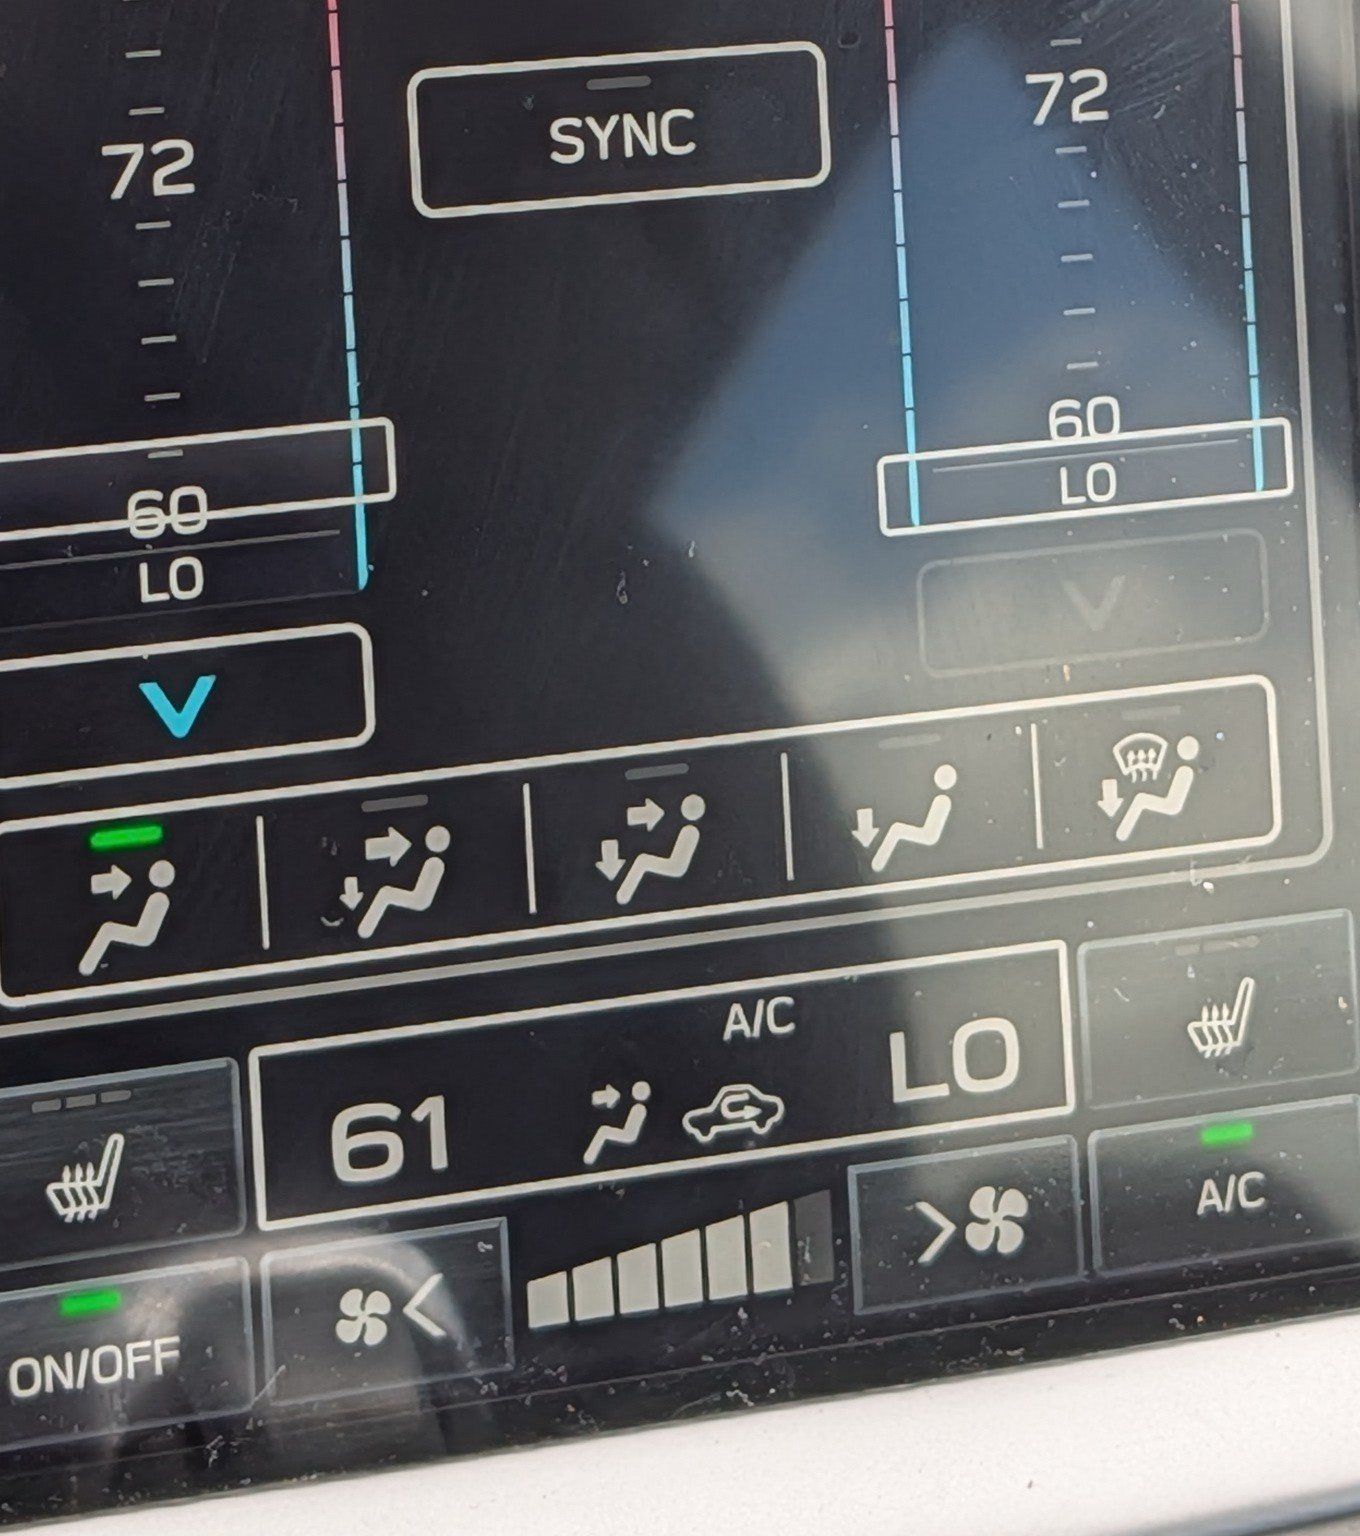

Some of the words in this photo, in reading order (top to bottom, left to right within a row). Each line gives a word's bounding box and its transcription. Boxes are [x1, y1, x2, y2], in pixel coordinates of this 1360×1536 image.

[1024, 68, 1110, 125] 72
[549, 108, 696, 164] SYNC
[101, 138, 195, 200] 72
[1048, 396, 1121, 438] 60
[1060, 462, 1117, 504] LO
[126, 486, 209, 537] 60
[139, 556, 204, 603] LO
[723, 995, 796, 1041] A/C
[890, 1017, 1020, 1103] LO
[331, 1095, 448, 1184] 61
[1197, 1171, 1266, 1215] A/C
[9, 1337, 181, 1398] ON/OFF
